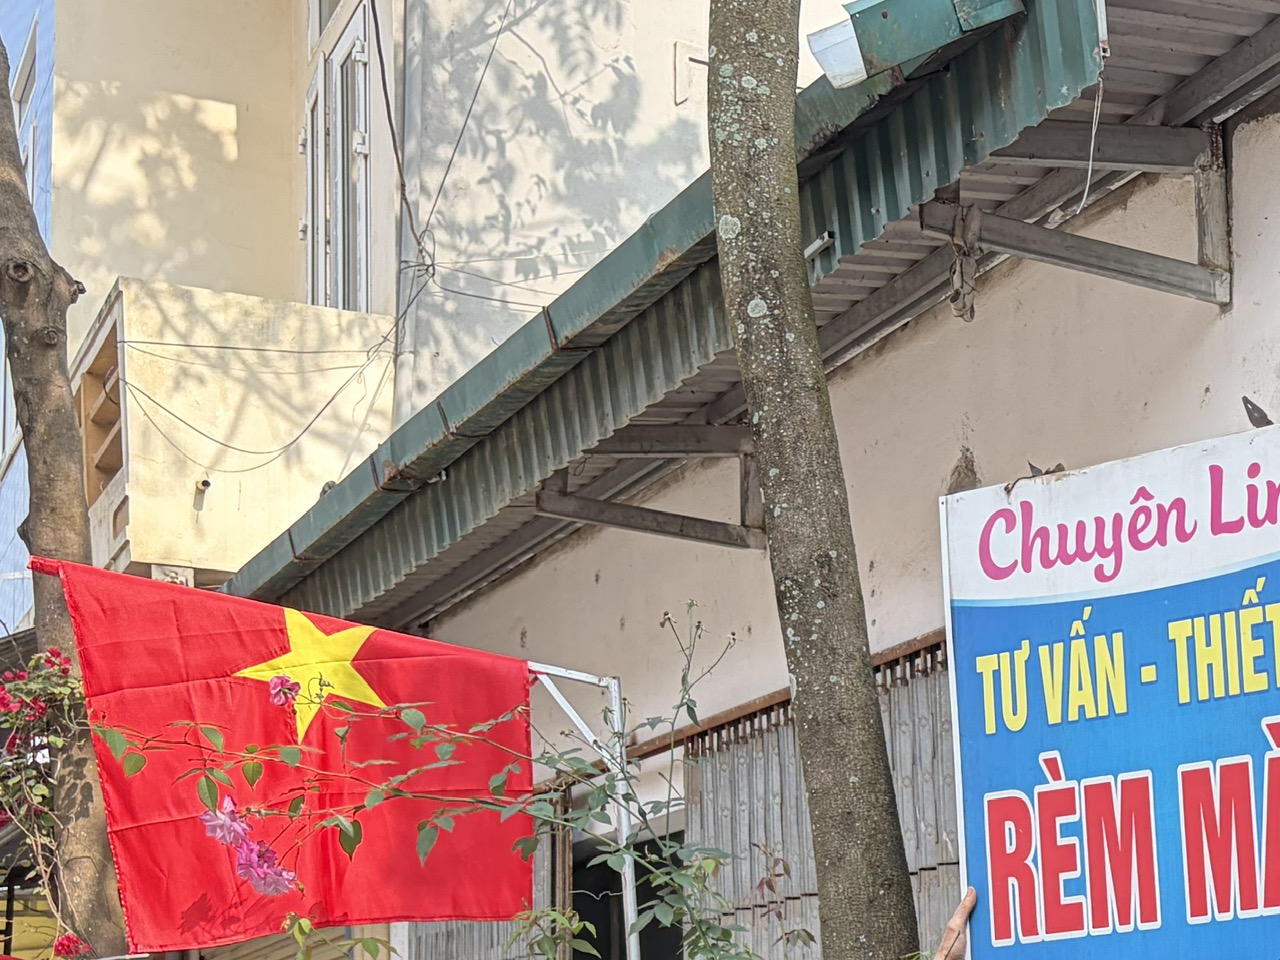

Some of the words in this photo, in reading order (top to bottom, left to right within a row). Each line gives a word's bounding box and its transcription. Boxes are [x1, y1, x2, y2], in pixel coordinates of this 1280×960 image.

[978, 485, 1198, 583] Chuyên
[975, 639, 1030, 735] TƯ
[1038, 605, 1128, 726] VẤN
[985, 751, 1161, 946] RÈM
